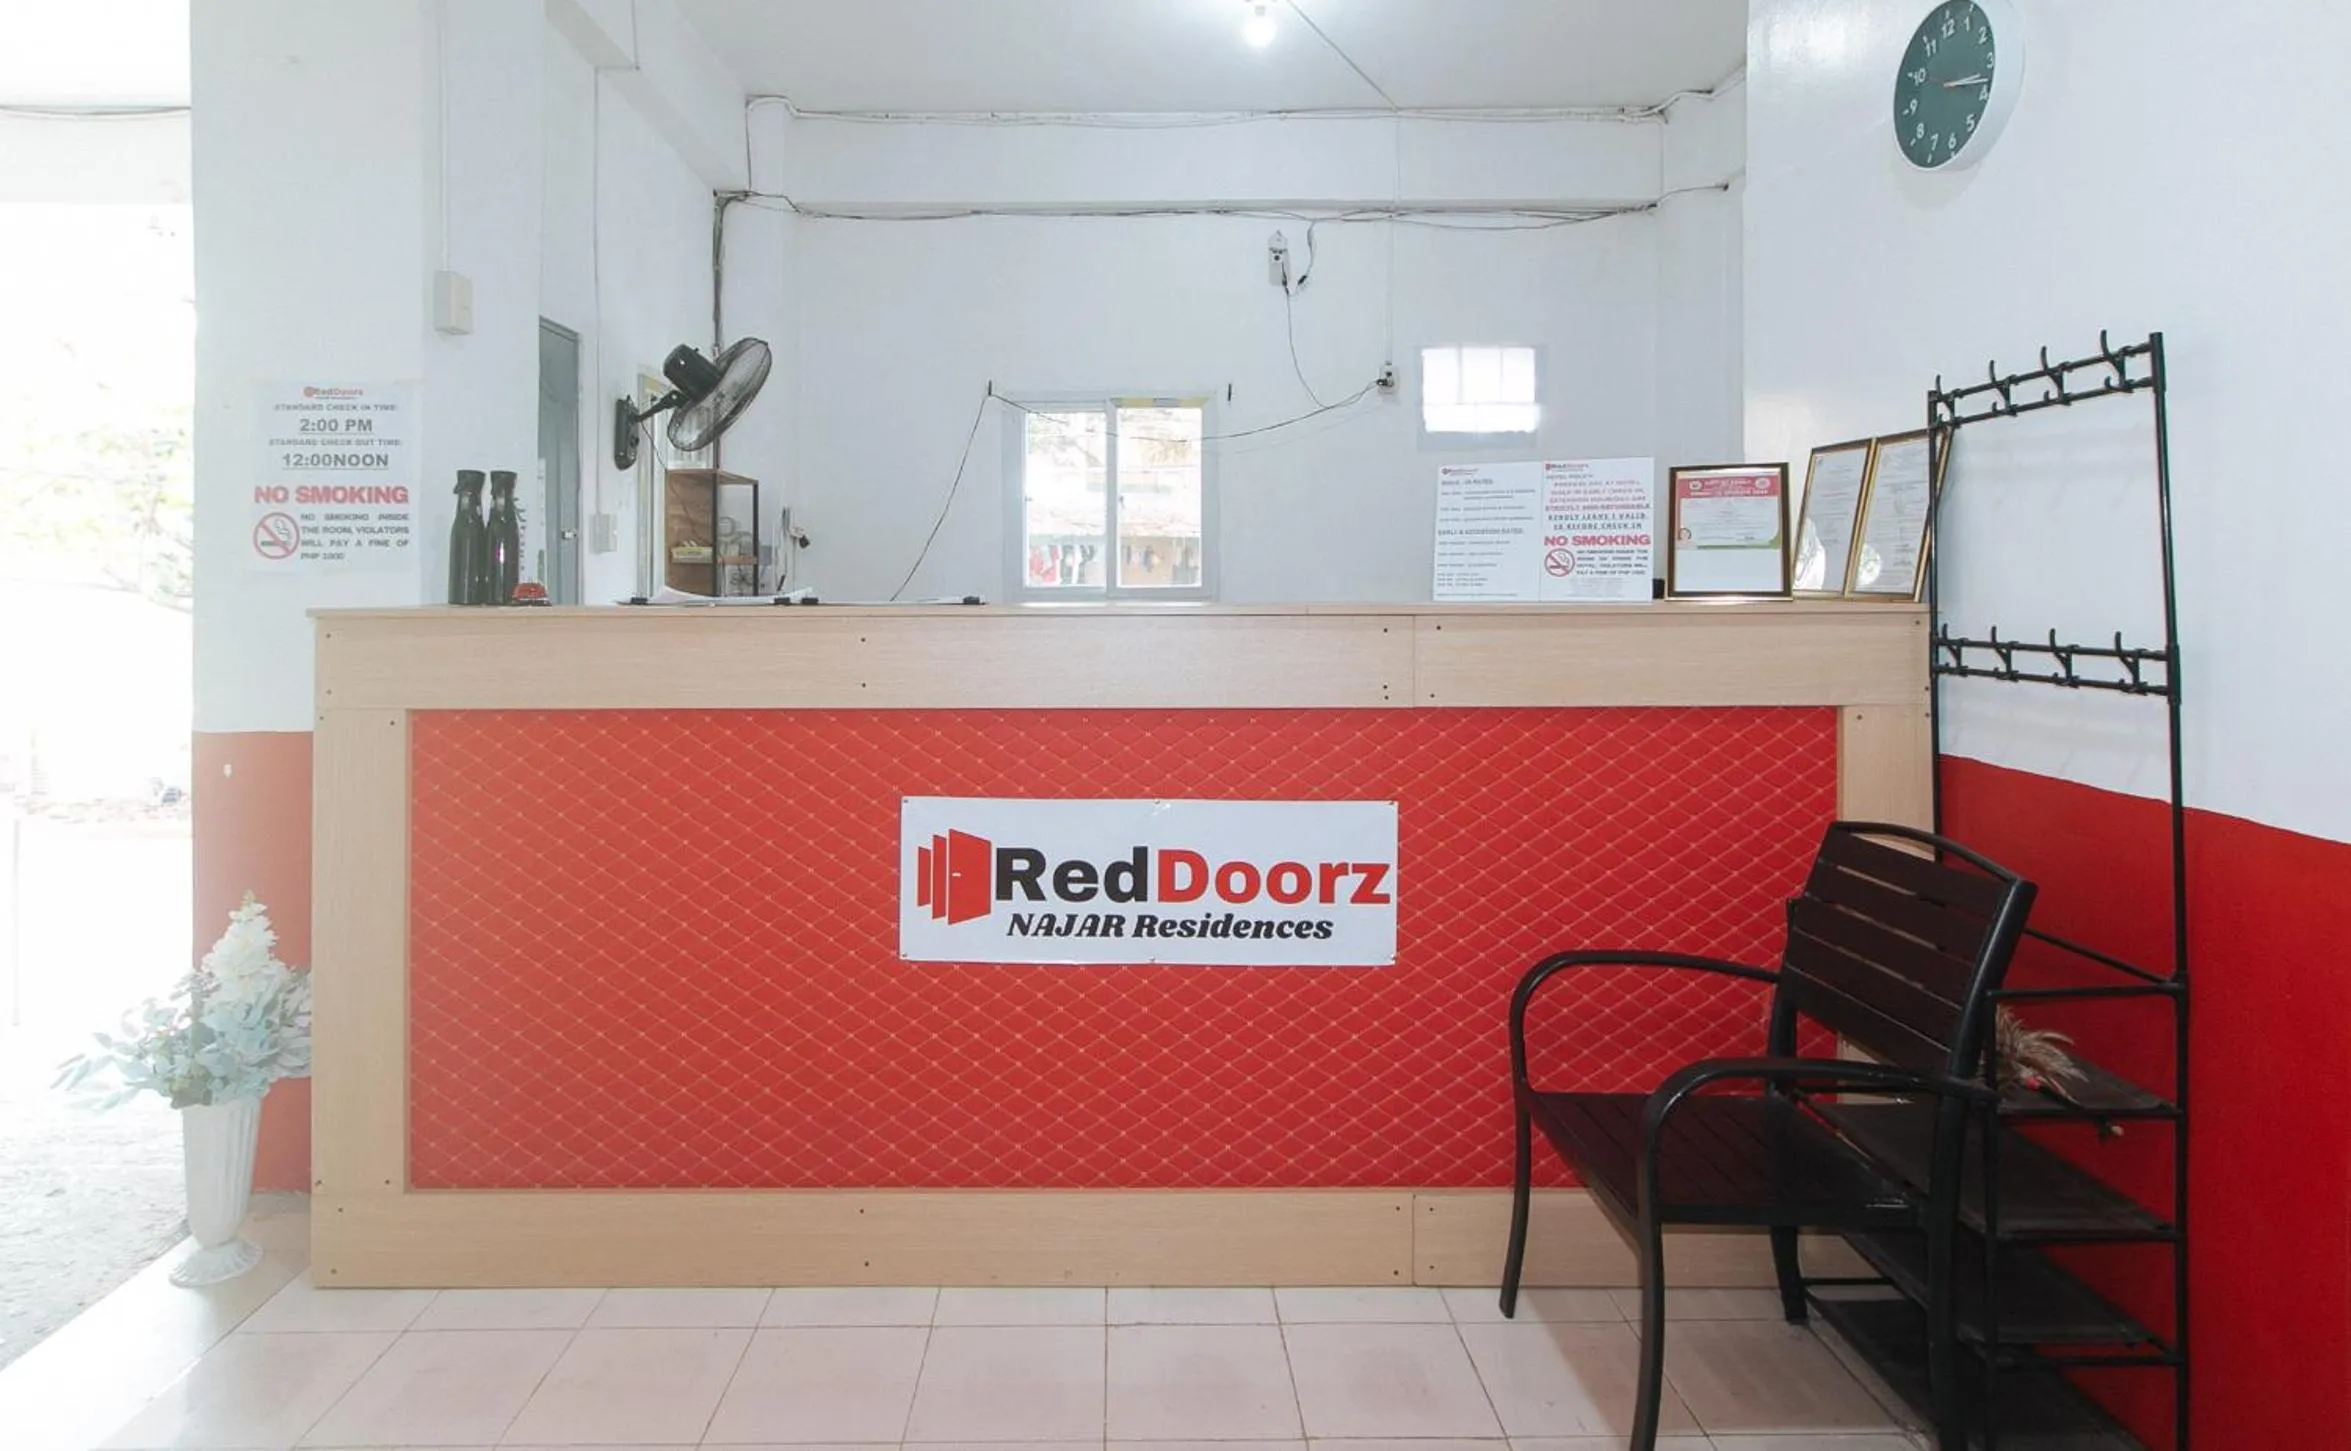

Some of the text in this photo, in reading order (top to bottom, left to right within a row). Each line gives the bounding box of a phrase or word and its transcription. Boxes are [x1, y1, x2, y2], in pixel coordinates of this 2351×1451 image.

[1941, 18, 1955, 38] 12
[1964, 16, 1970, 31] 1
[1978, 26, 1988, 44] 2
[1925, 39, 1937, 57] 11
[1986, 52, 1994, 69] 3
[1913, 68, 1926, 86] 10
[1979, 84, 1989, 101] 4
[1909, 98, 1917, 115] 9
[1916, 123, 1925, 139] 8
[1966, 114, 1975, 132] 5
[1930, 133, 1939, 151] 7
[1948, 132, 1957, 149] 6
[274, 403, 323, 411] STANDARD
[326, 403, 358, 411] CHECK
[360, 403, 371, 411] IN
[300, 418, 373, 432] 2:00 PM
[282, 453, 389, 466] 12:00NOON
[254, 485, 410, 503] NO SMOKING
[301, 513, 410, 521] NO SMOKING INSIDE
[301, 526, 318, 534] THE
[356, 526, 410, 534] VIOLATORS
[301, 539, 410, 547] WILL PAY A FINE OF
[1544, 534, 1651, 546] NO SMOKING
[996, 846, 1391, 905] RedDoorz
[1006, 912, 1334, 940] NAJAR Residences
